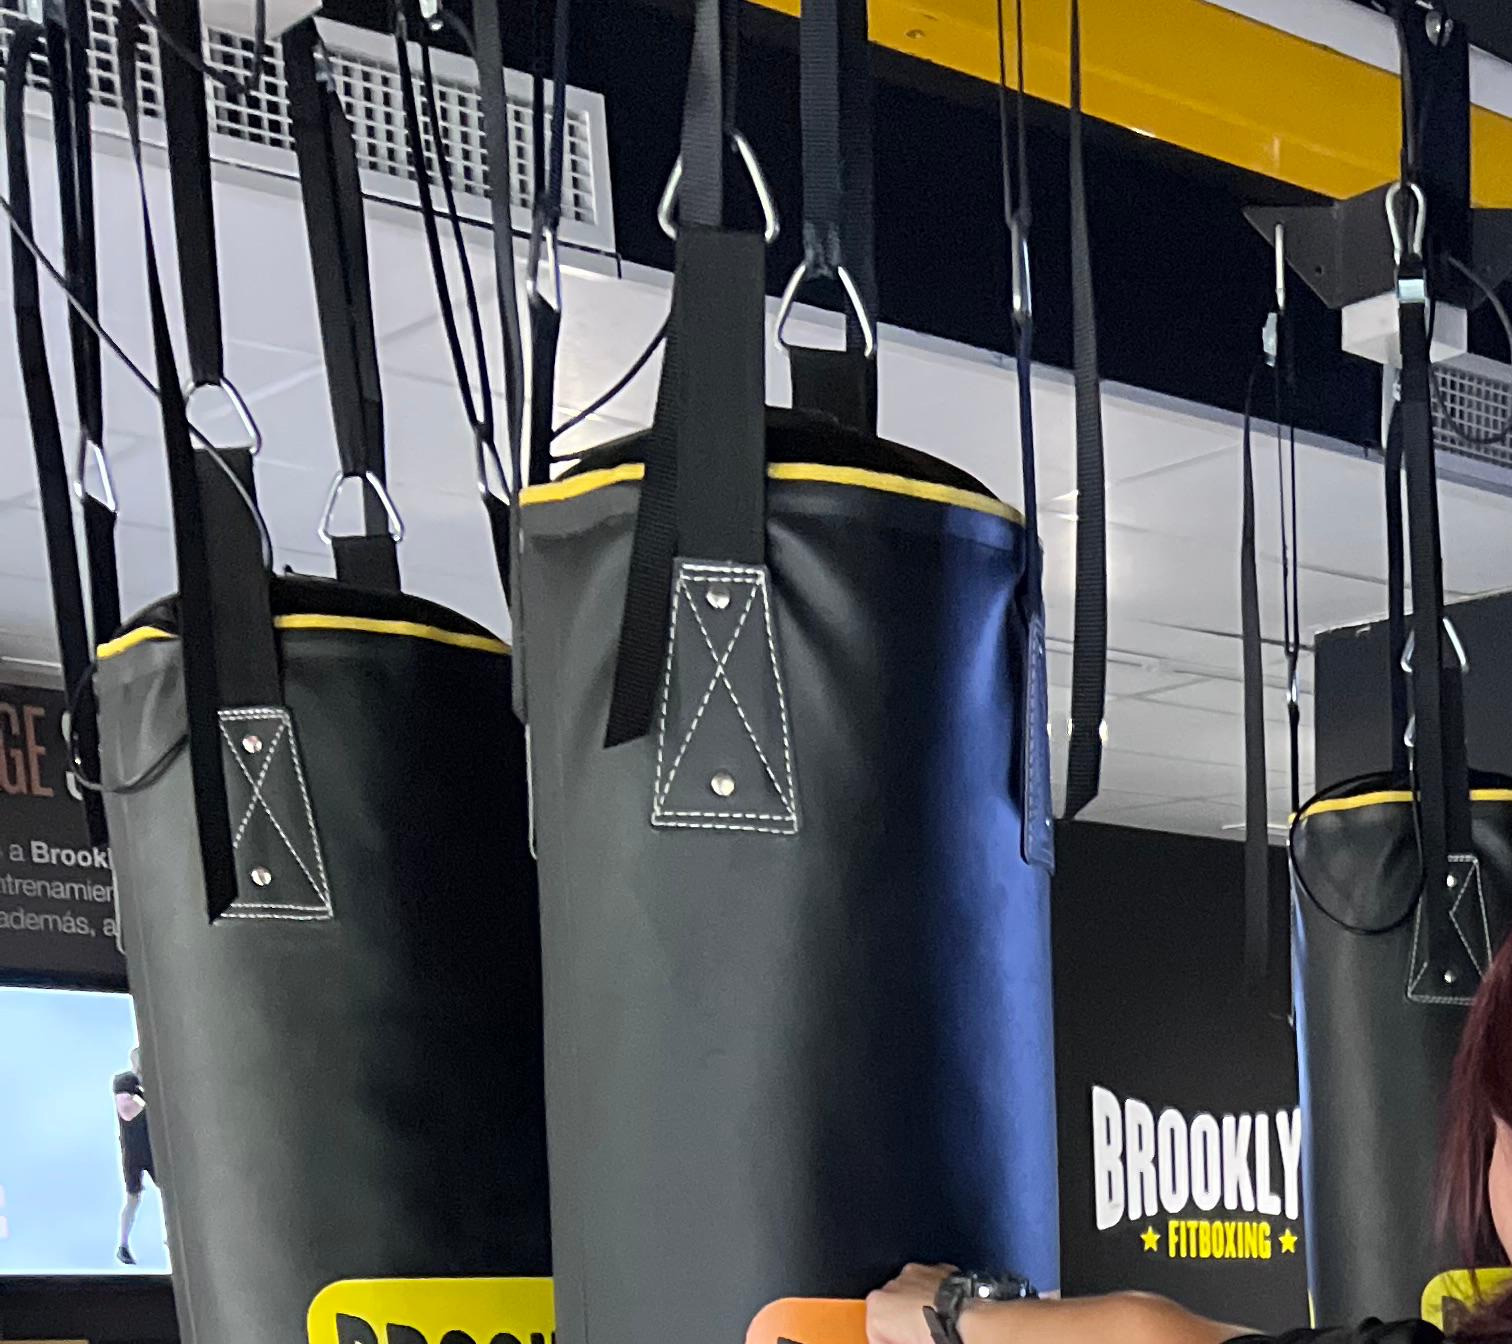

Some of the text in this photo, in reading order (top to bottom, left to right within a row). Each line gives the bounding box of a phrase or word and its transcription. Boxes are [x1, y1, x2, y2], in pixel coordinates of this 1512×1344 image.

[9, 844, 25, 862] a
[1092, 1085, 1300, 1231] BROOKLY
[1167, 1219, 1272, 1260] FITBOXING
